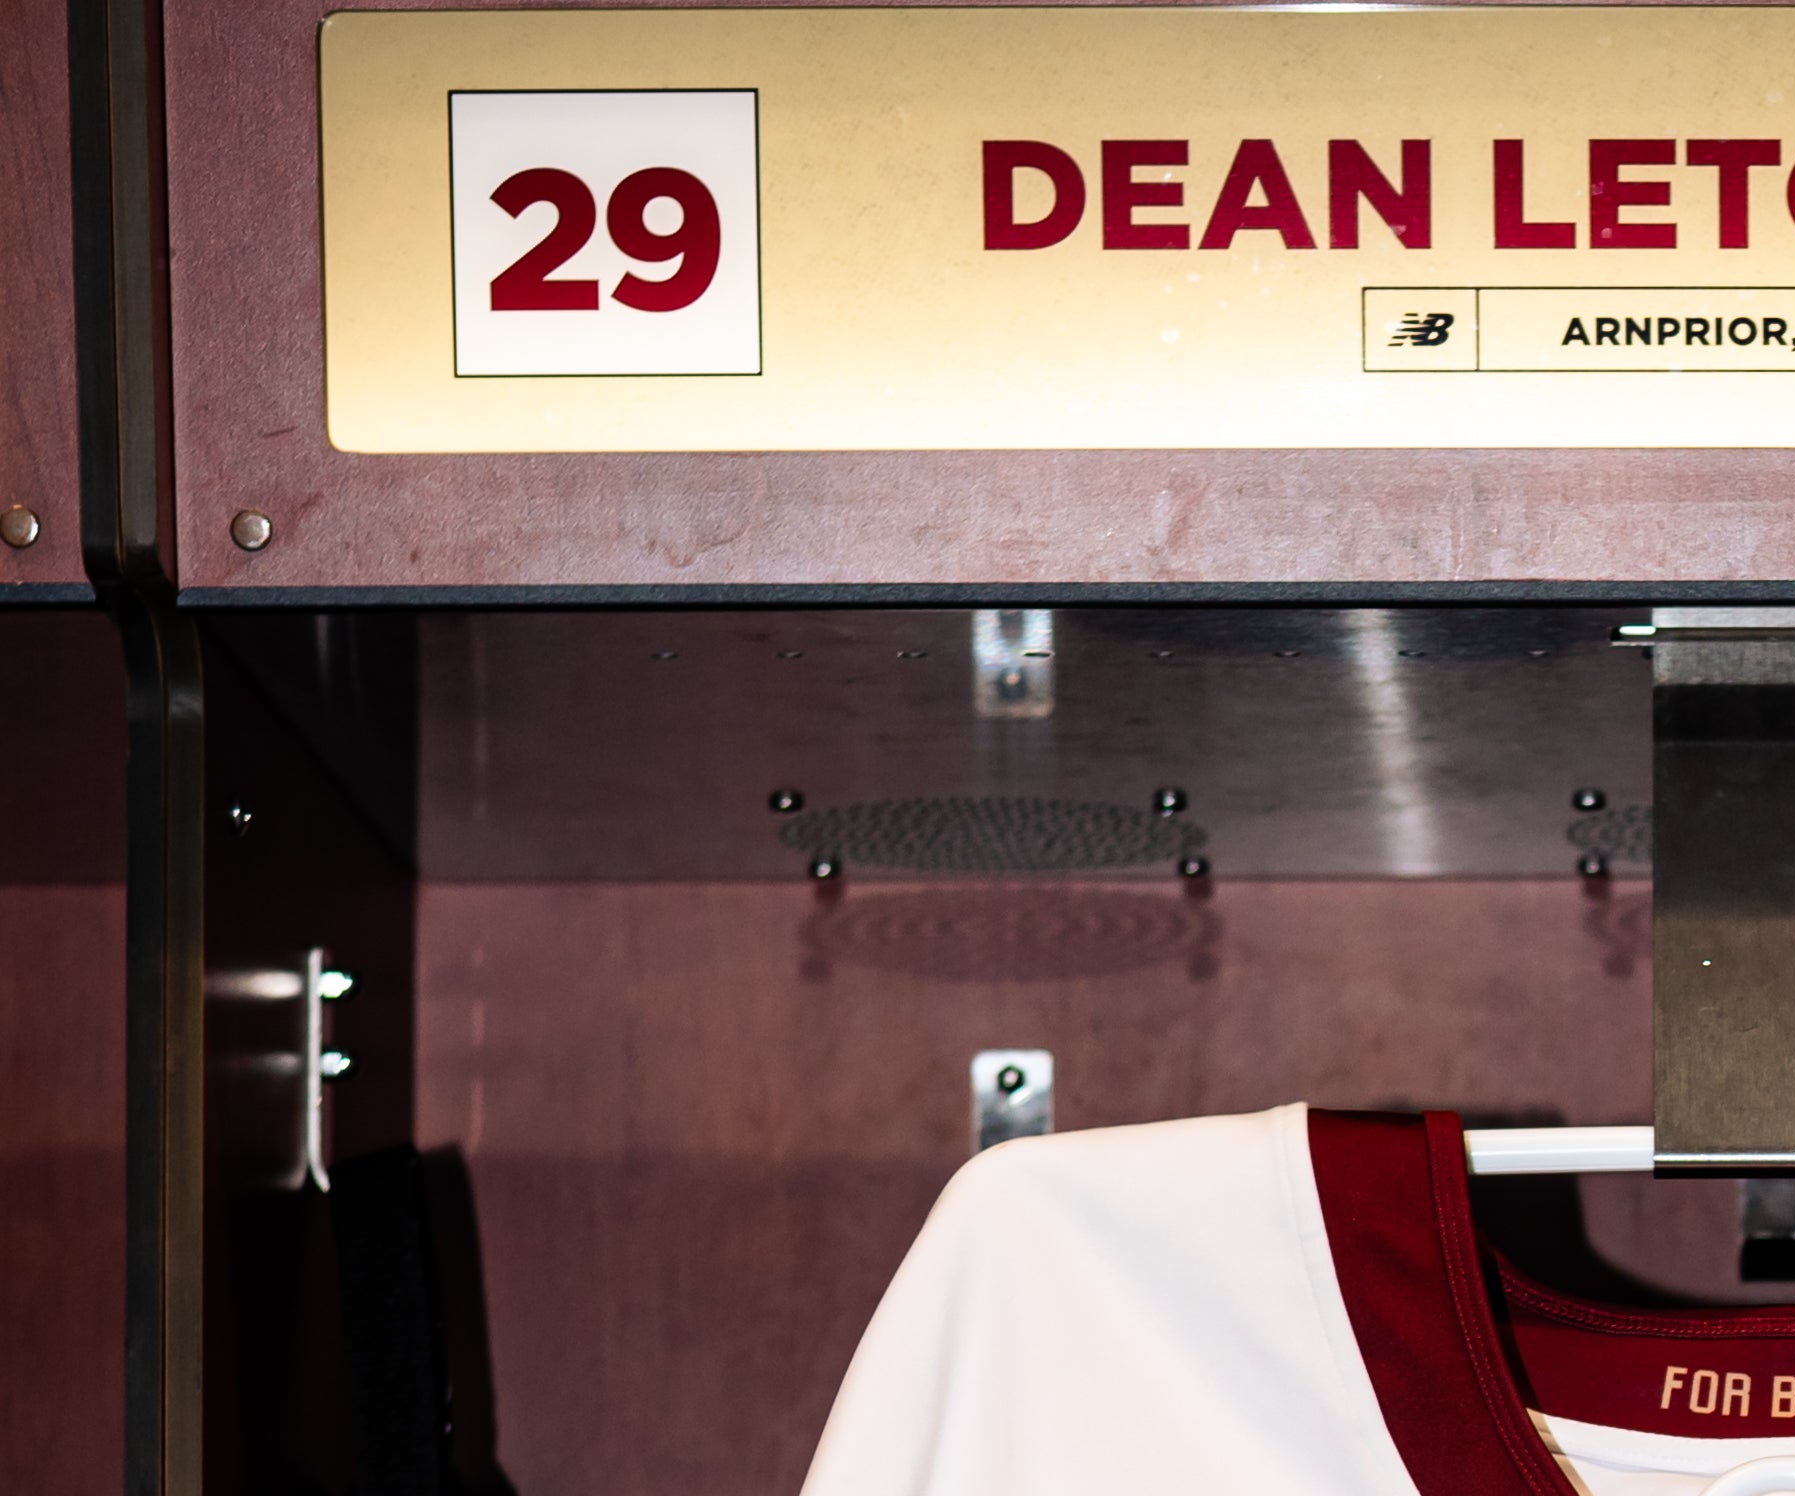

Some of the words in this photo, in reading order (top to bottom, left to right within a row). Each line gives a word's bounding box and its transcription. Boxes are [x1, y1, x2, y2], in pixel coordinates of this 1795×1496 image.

[488, 165, 722, 313] 29
[981, 138, 1433, 251] DEAN
[1660, 1365, 1752, 1417] FOR
